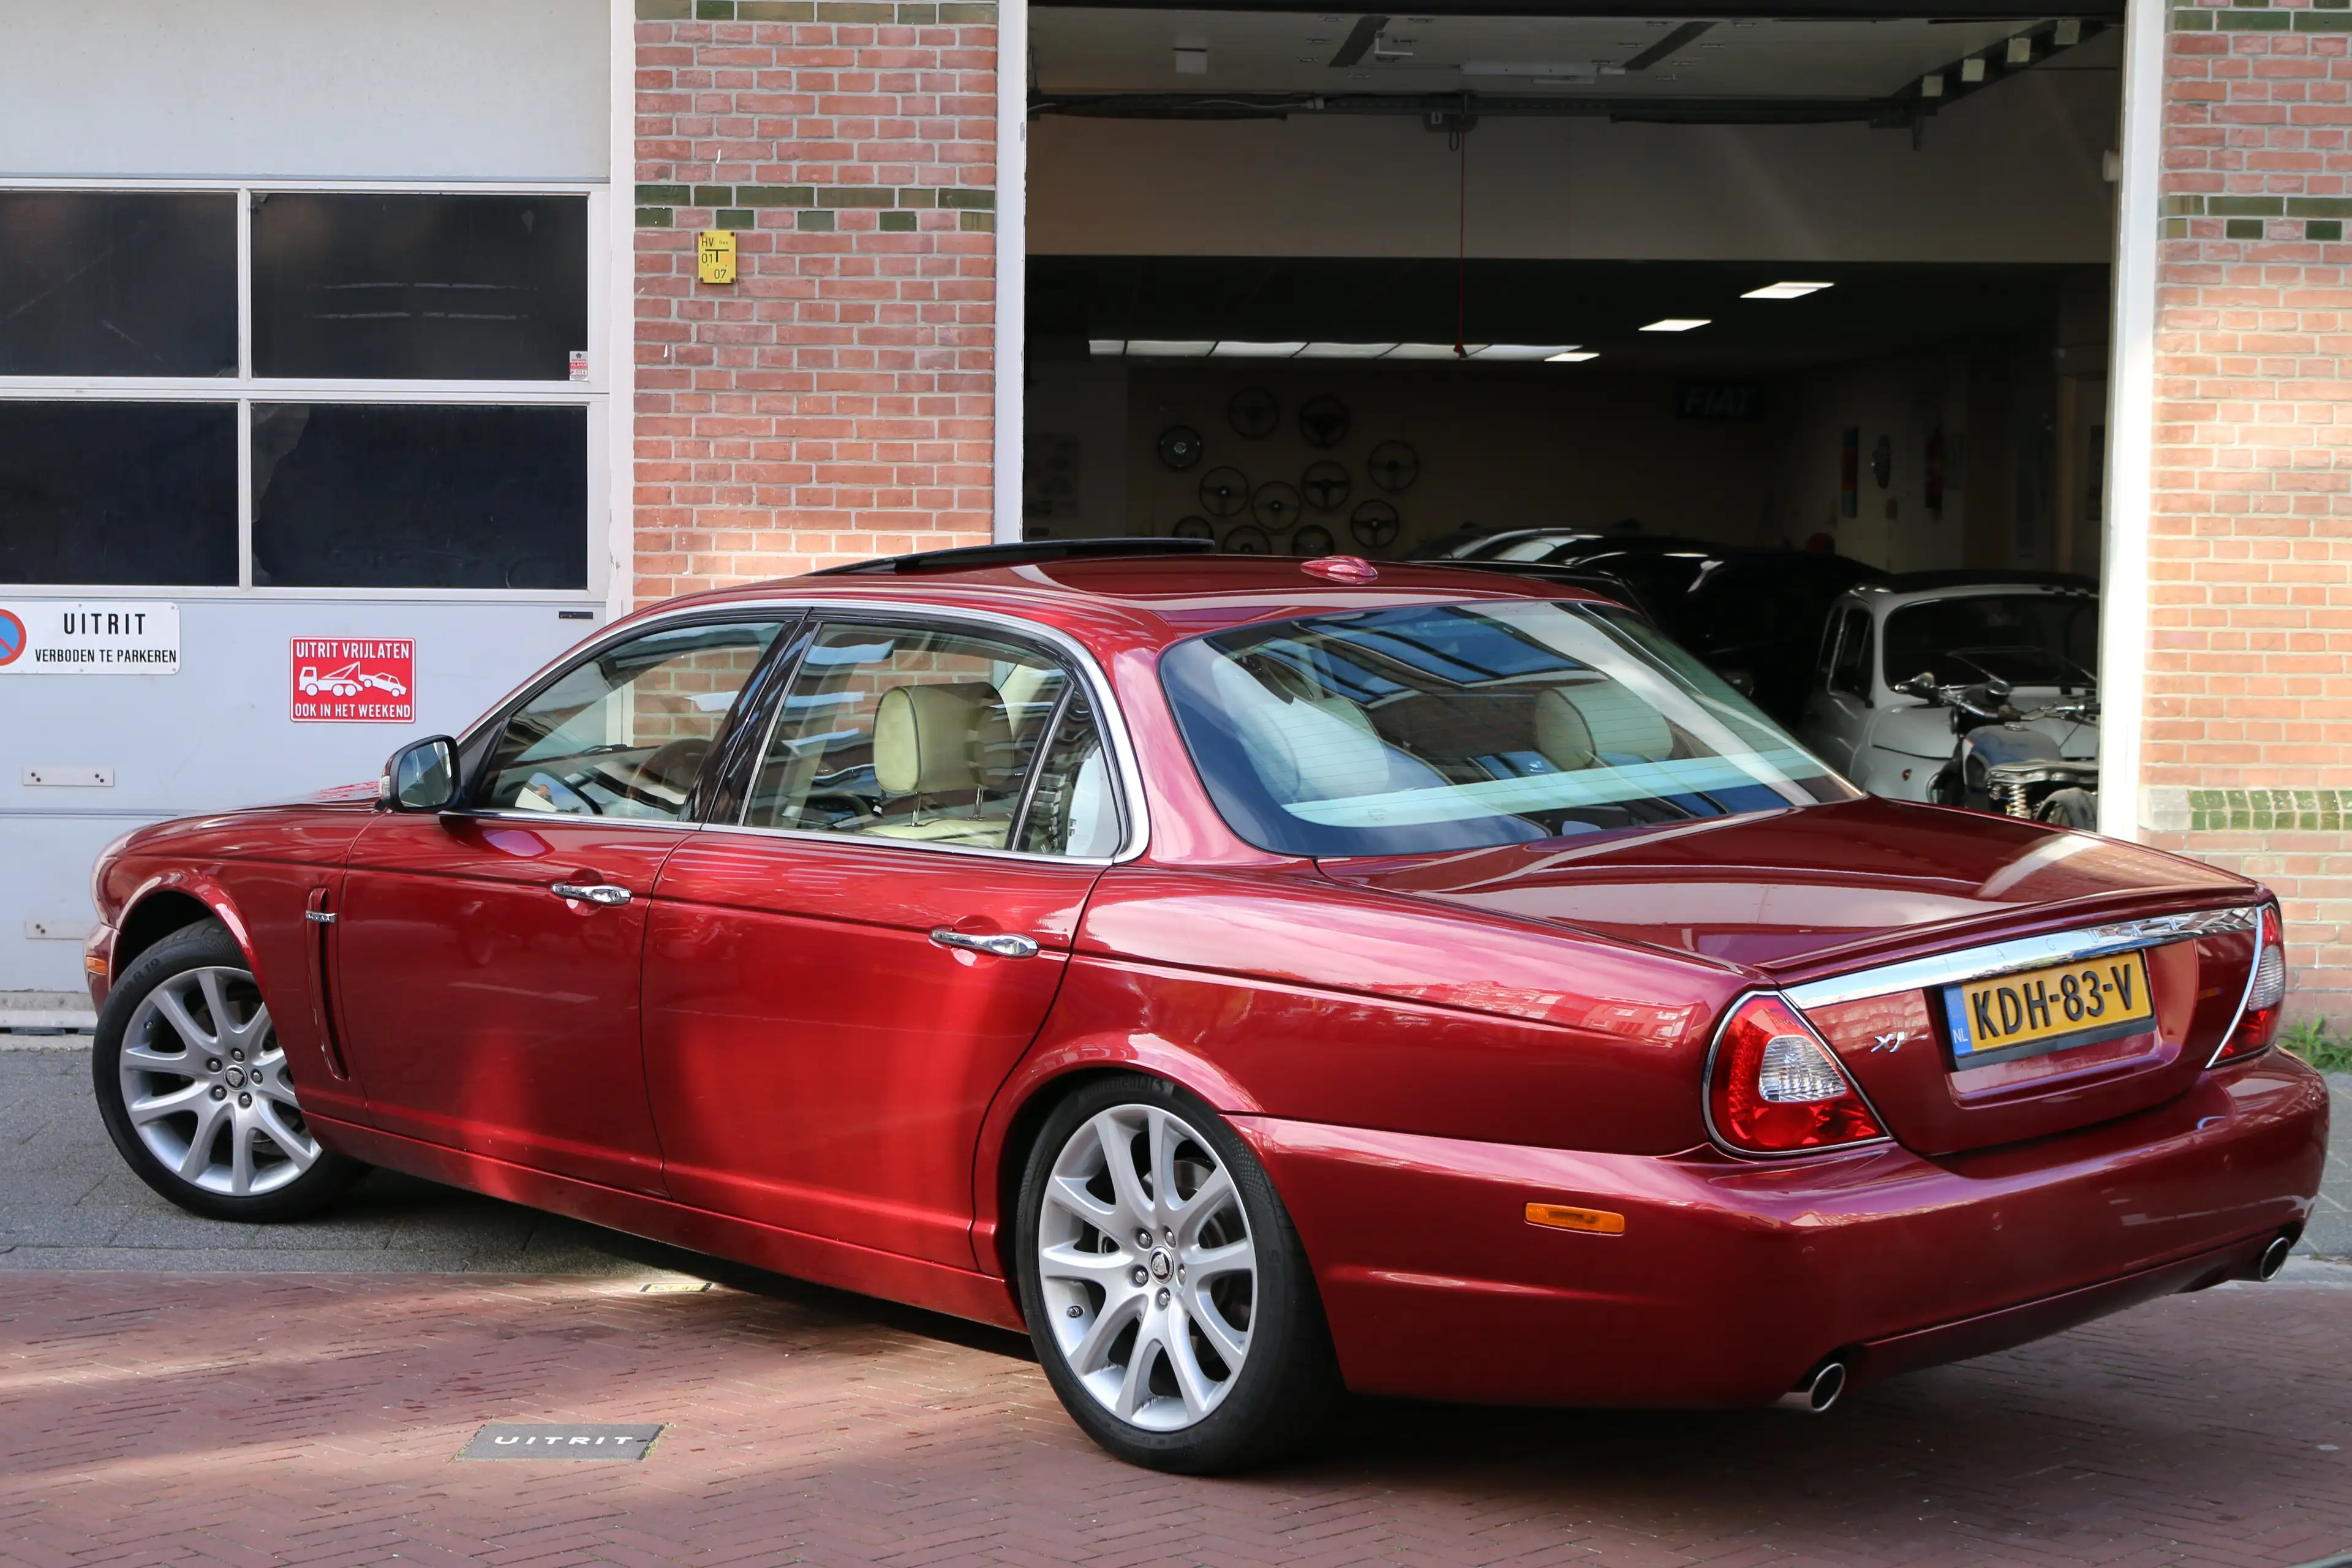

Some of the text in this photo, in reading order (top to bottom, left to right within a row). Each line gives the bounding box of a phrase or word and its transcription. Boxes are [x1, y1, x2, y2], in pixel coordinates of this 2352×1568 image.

[702, 238, 714, 247] HV
[1685, 386, 1755, 417] FIAT
[63, 613, 146, 635] UITRIT
[35, 649, 176, 663] VERBODEN TE PARKEREN
[296, 642, 410, 658] UITRIT VRIJLATEN
[295, 703, 410, 718] OOK IN HET WEEKEND
[1972, 963, 2132, 1041] KDH-83-V
[1953, 1028, 1969, 1044] NL
[494, 1436, 633, 1445] UITRIT
